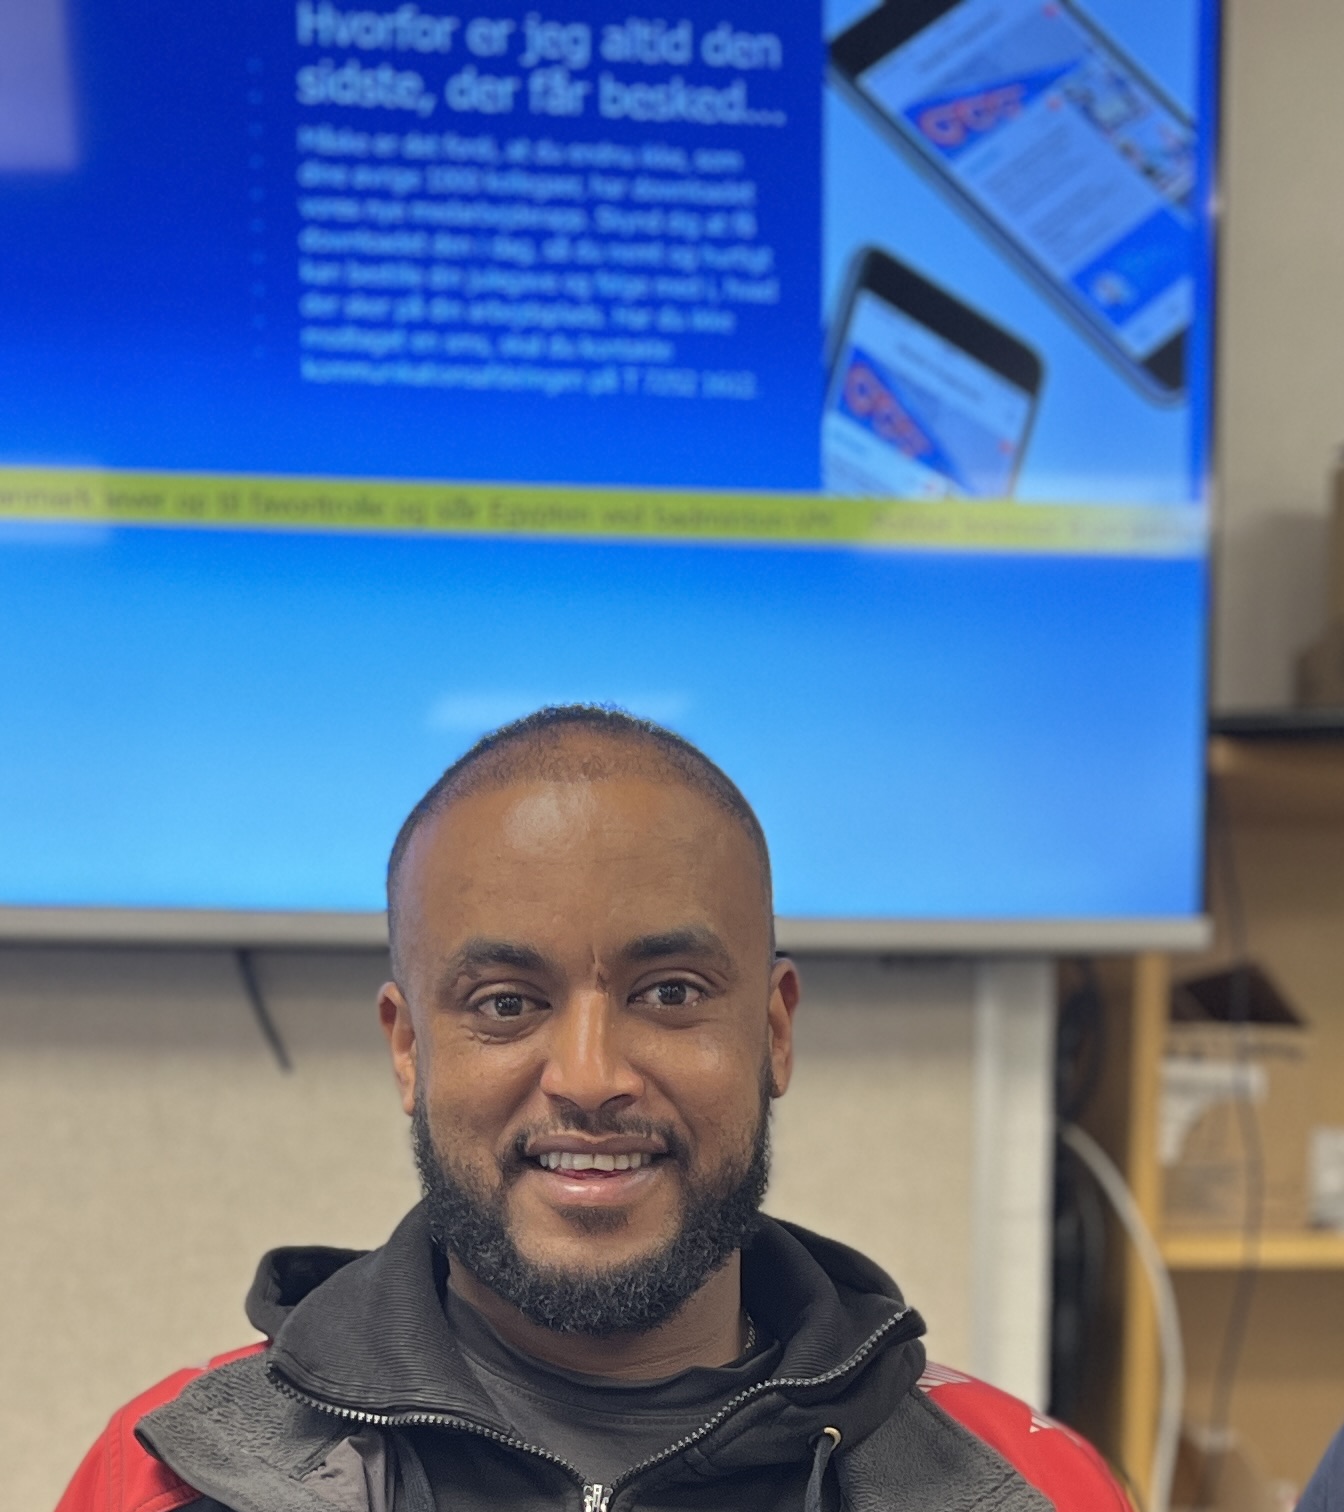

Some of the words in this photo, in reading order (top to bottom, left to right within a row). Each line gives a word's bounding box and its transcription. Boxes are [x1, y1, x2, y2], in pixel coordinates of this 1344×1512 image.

[297, 3, 457, 53] Hvorfor
[467, 20, 514, 54] er
[520, 12, 591, 68] jeg
[598, 17, 691, 63] altid
[700, 22, 781, 68] den
[296, 63, 436, 115] sidste,
[447, 67, 519, 113] der
[528, 67, 590, 115] får
